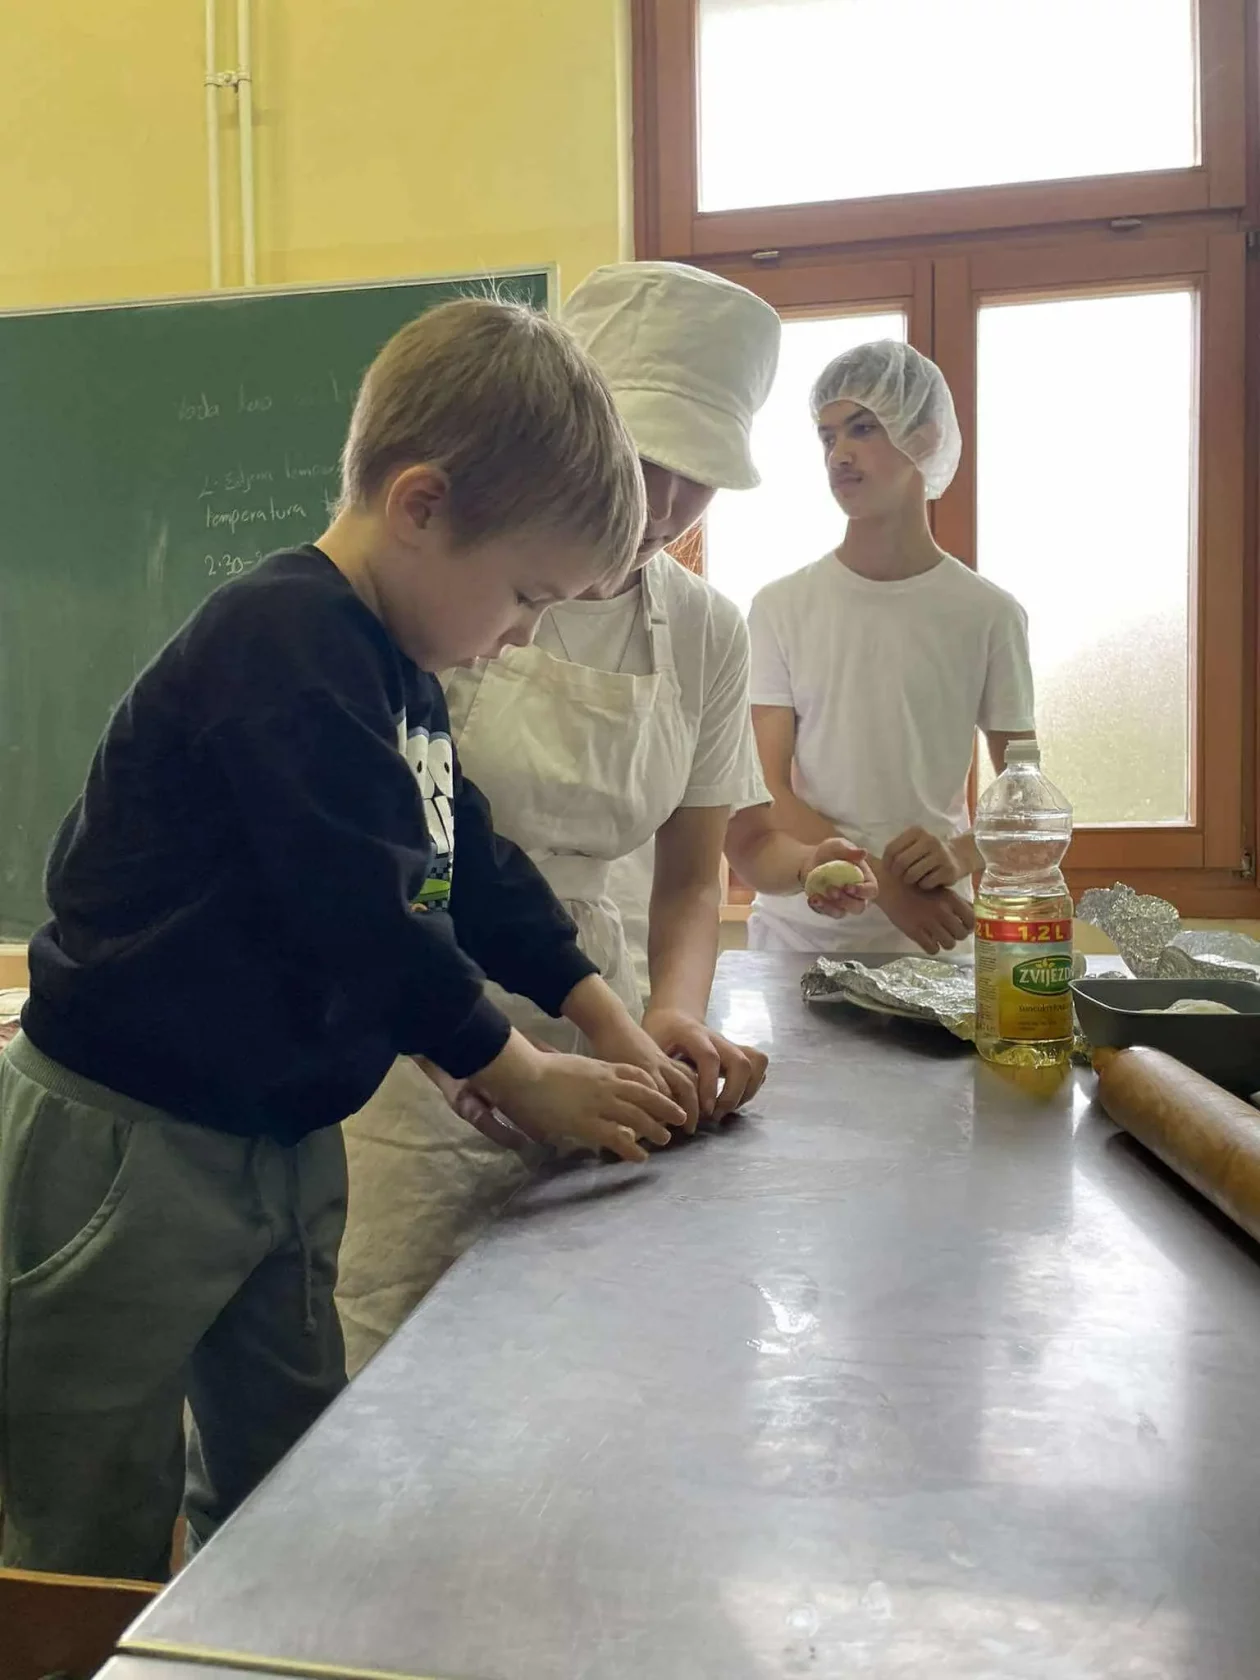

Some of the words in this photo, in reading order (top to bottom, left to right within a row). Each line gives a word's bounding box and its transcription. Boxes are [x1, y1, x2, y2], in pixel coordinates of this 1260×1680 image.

[206, 496, 307, 535] temperatura
[985, 923, 994, 939] L
[1055, 924, 1064, 941] L
